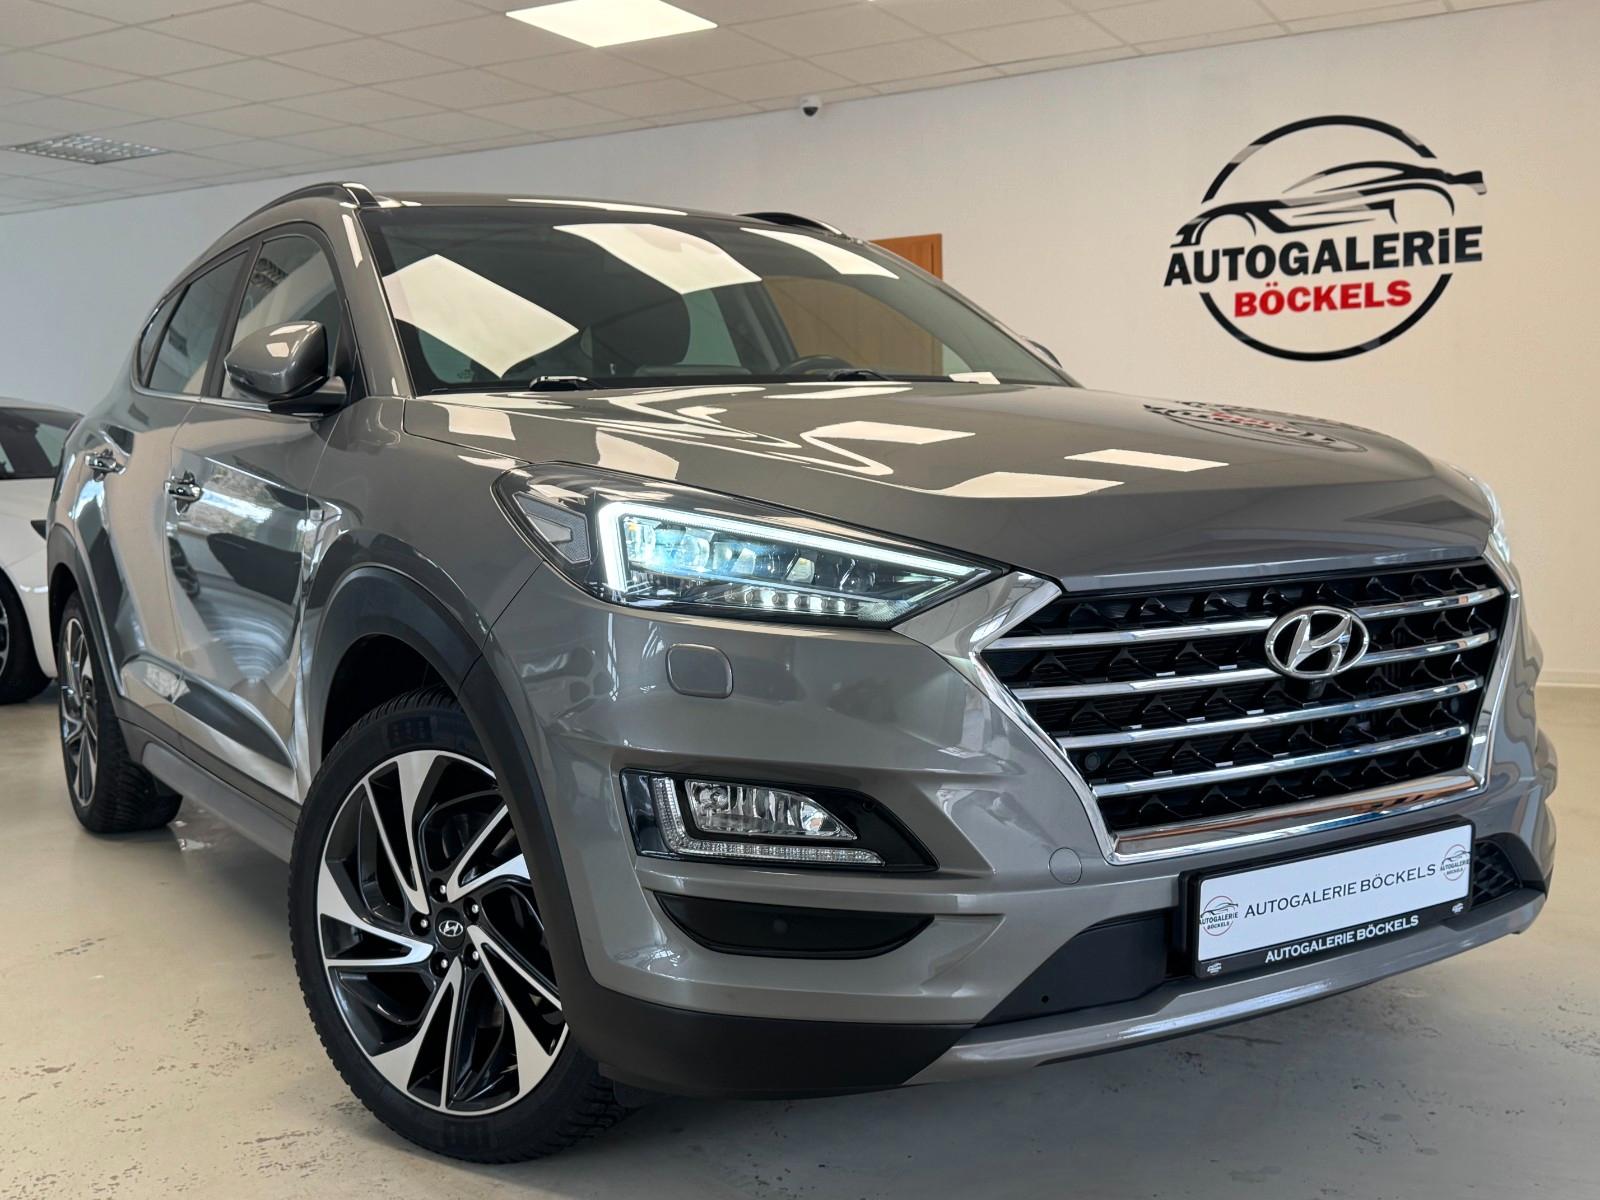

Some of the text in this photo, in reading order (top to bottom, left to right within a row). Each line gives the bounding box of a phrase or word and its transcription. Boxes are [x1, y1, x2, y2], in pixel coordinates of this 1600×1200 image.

[1234, 281, 1412, 317] BÖCKELS
[1245, 863, 1436, 918] AUTOGALERIE BÖCKELS
[1265, 915, 1420, 963] AUTOGALERIE BÖCKELS
